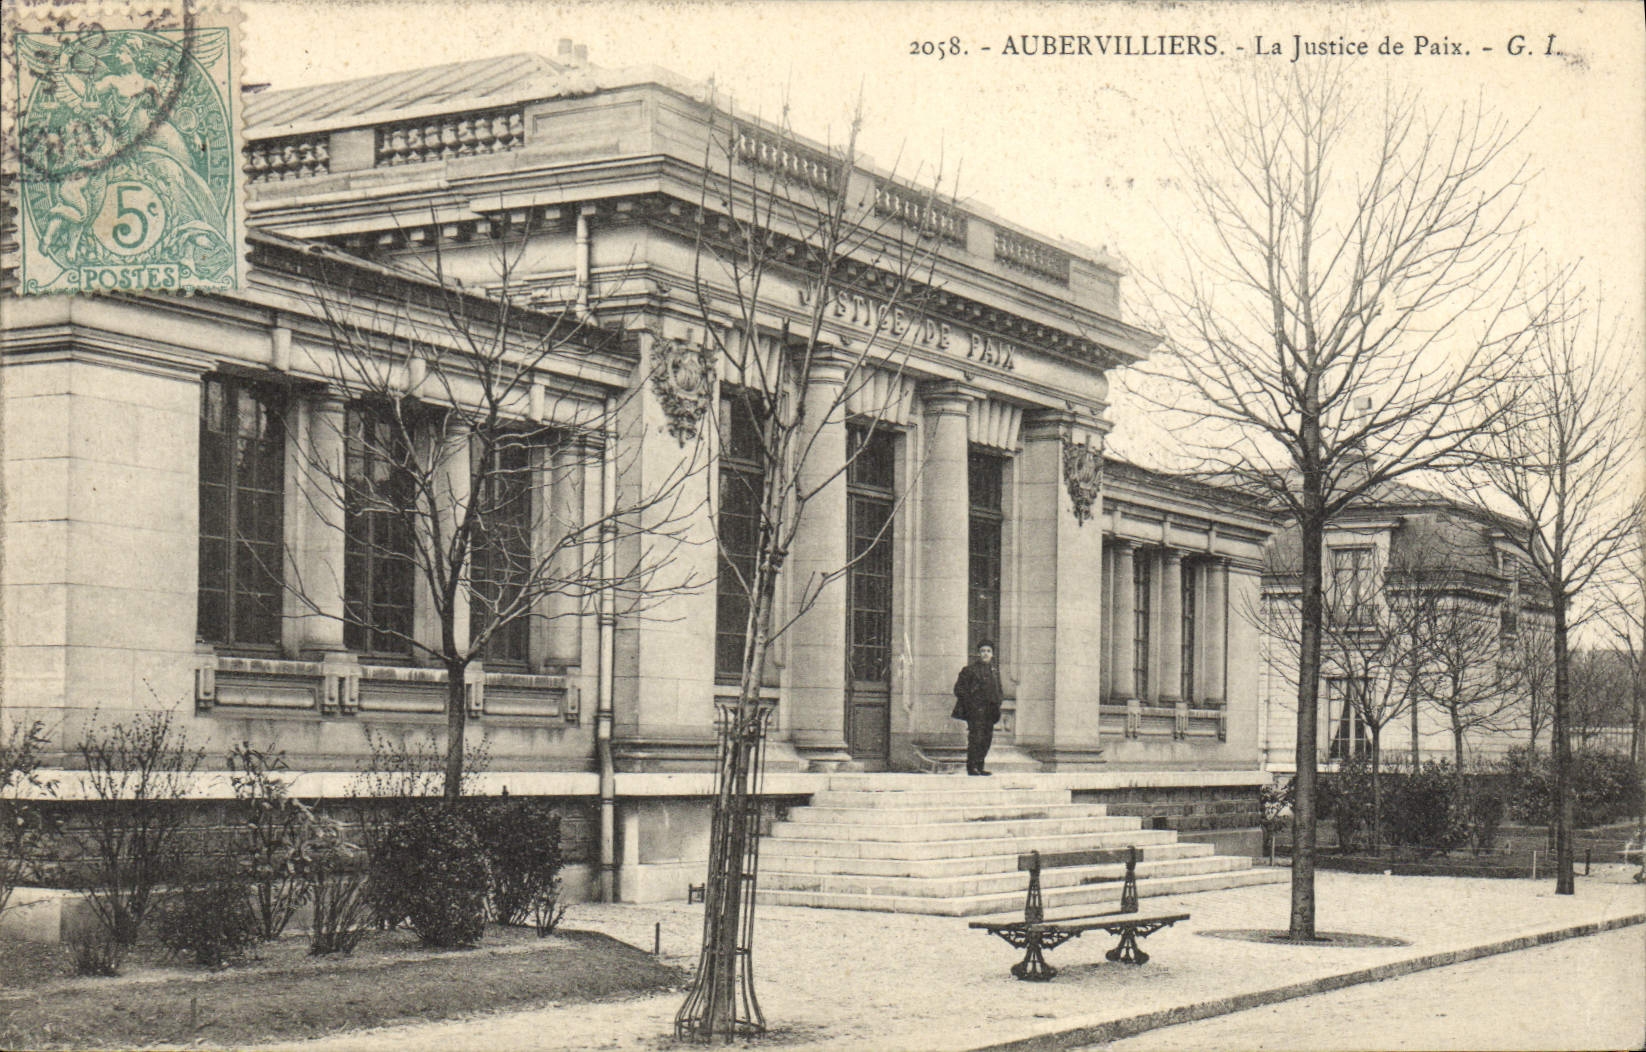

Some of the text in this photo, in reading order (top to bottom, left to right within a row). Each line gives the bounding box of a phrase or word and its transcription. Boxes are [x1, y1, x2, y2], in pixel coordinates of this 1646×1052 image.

[83, 268, 176, 289] POSTES
[922, 317, 952, 349] DE
[967, 332, 1016, 370] PAIX
